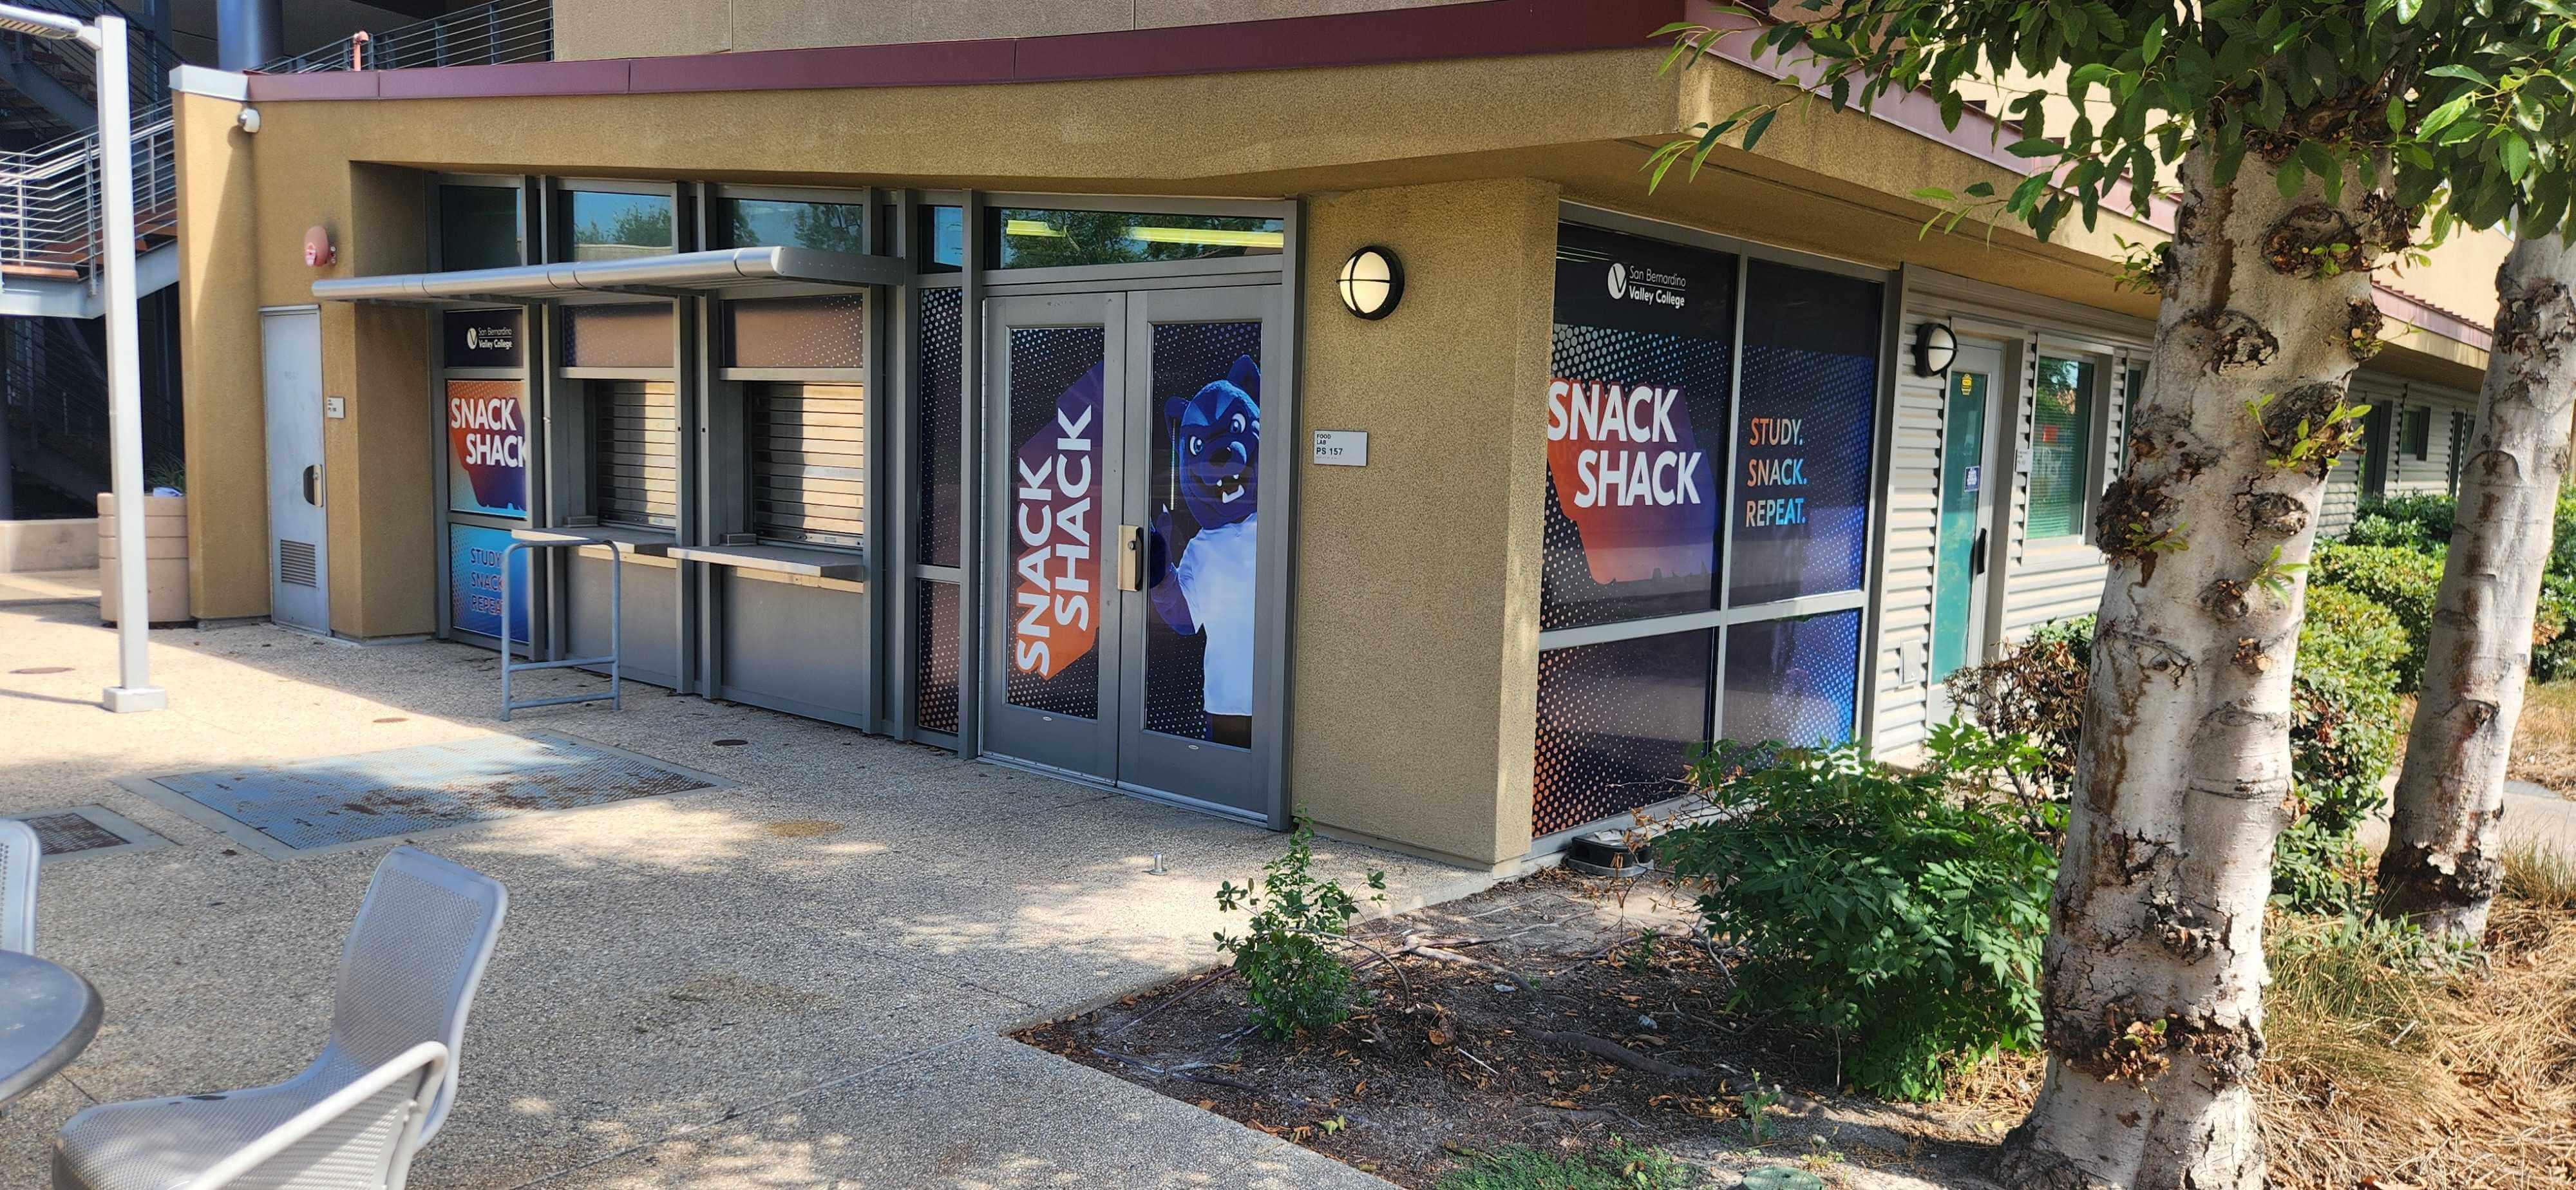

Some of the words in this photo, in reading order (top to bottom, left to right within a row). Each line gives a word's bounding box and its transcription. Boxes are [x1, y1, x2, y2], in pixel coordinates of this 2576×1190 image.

[1629, 265, 1644, 280] San
[1646, 269, 1686, 287] Bernardino
[1629, 285, 1654, 305] Valley
[1656, 290, 1685, 308] College
[478, 339, 493, 350] Valley
[494, 339, 513, 350] College
[451, 398, 516, 431] SNACK
[1548, 381, 1678, 442] SNACK
[1750, 417, 1803, 446] STUDY.
[466, 433, 526, 468] SHACK
[1574, 449, 1701, 507] SHACK
[1747, 458, 1807, 487] SNACK.
[1054, 404, 1092, 632] SHACK
[1746, 497, 1806, 527] REPEAT.
[1018, 455, 1052, 676] SNACK
